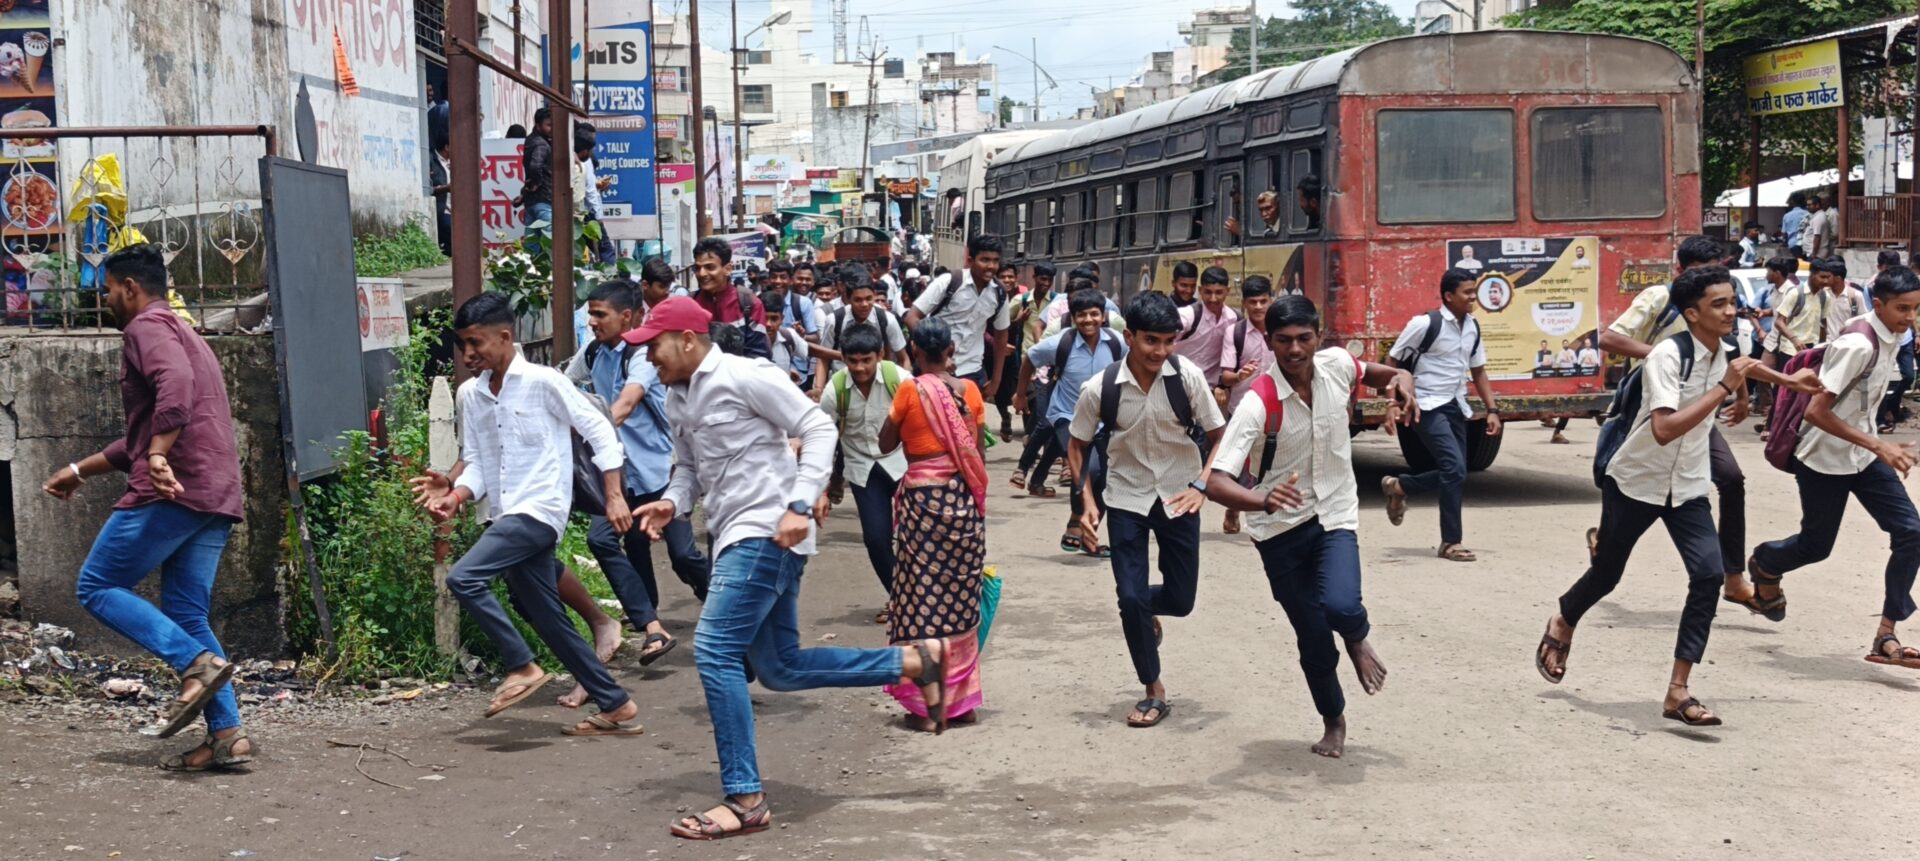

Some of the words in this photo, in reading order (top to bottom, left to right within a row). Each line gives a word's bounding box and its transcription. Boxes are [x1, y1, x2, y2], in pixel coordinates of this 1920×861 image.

[572, 82, 645, 111] MPUTERS
[1774, 95, 1782, 109] व
[1783, 92, 1804, 108] फळ
[1806, 81, 1838, 105] मार्केट
[596, 119, 642, 129] INSTITUTE
[606, 142, 630, 154] TALLY
[596, 156, 618, 170] ping
[619, 157, 650, 168] Courses
